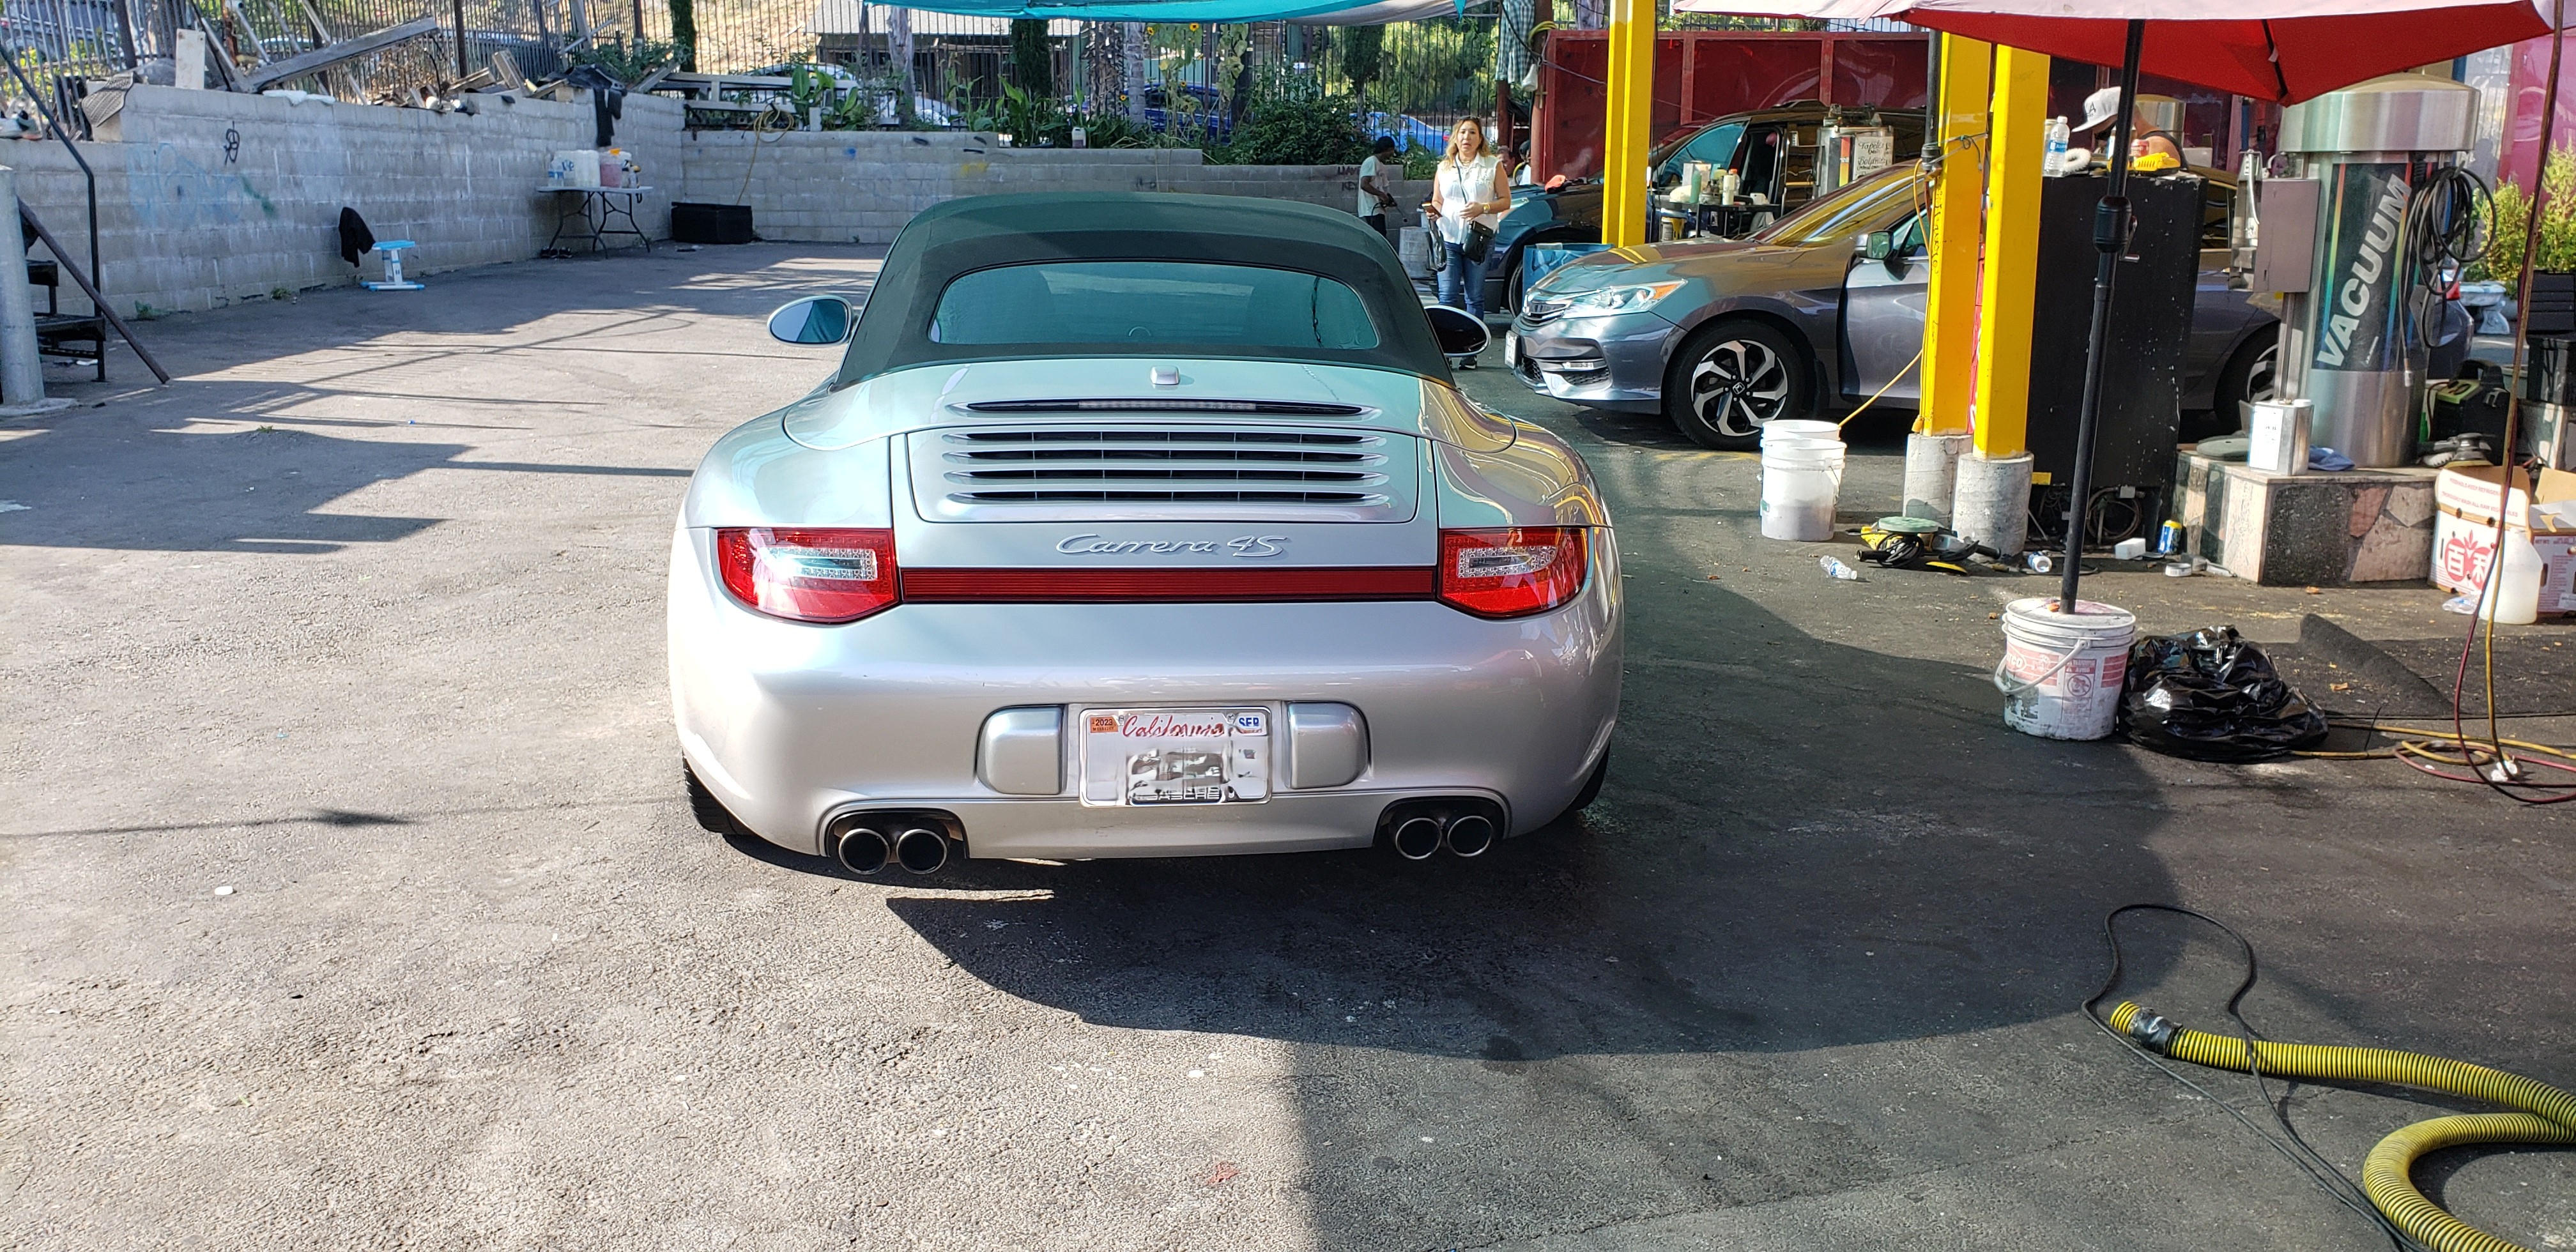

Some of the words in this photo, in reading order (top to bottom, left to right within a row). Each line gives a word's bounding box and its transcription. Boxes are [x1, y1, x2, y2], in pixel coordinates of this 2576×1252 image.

[2317, 174, 2412, 367] VACUUM
[1055, 533, 1215, 554] Carrera
[1226, 535, 1288, 557] 4S
[1123, 715, 1225, 737] California
[1239, 717, 1259, 726] SEP
